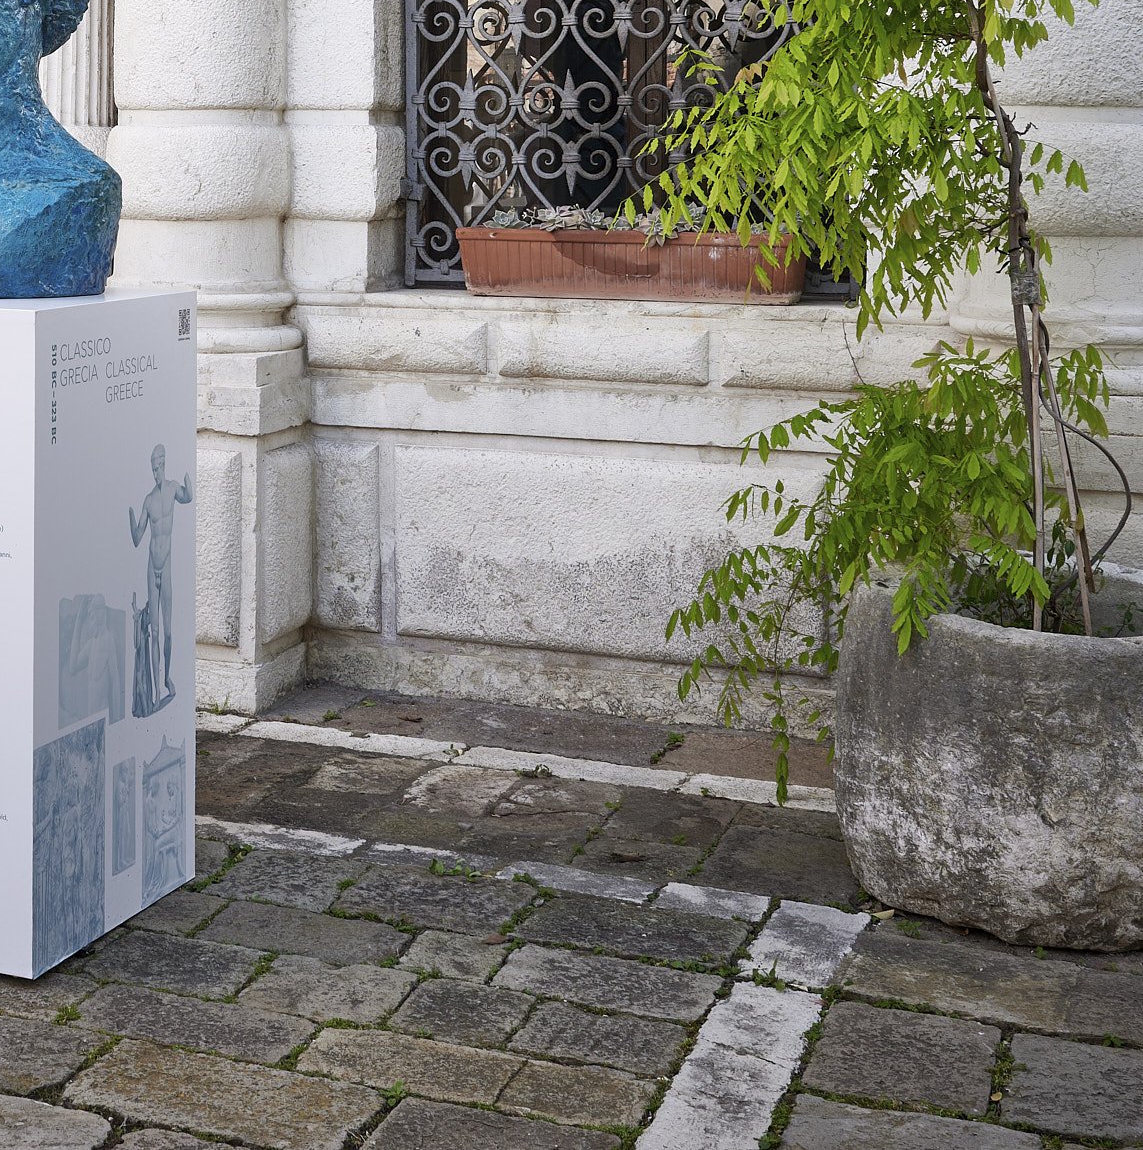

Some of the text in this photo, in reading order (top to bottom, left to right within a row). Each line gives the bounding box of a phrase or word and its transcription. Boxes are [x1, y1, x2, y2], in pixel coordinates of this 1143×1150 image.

[60, 337, 111, 361] CLASSICO
[60, 365, 99, 387] GRECIA
[105, 355, 158, 379] CLASSICAL
[51, 371, 57, 388] BC
[105, 380, 144, 403] GREECE
[51, 427, 57, 446] BC
